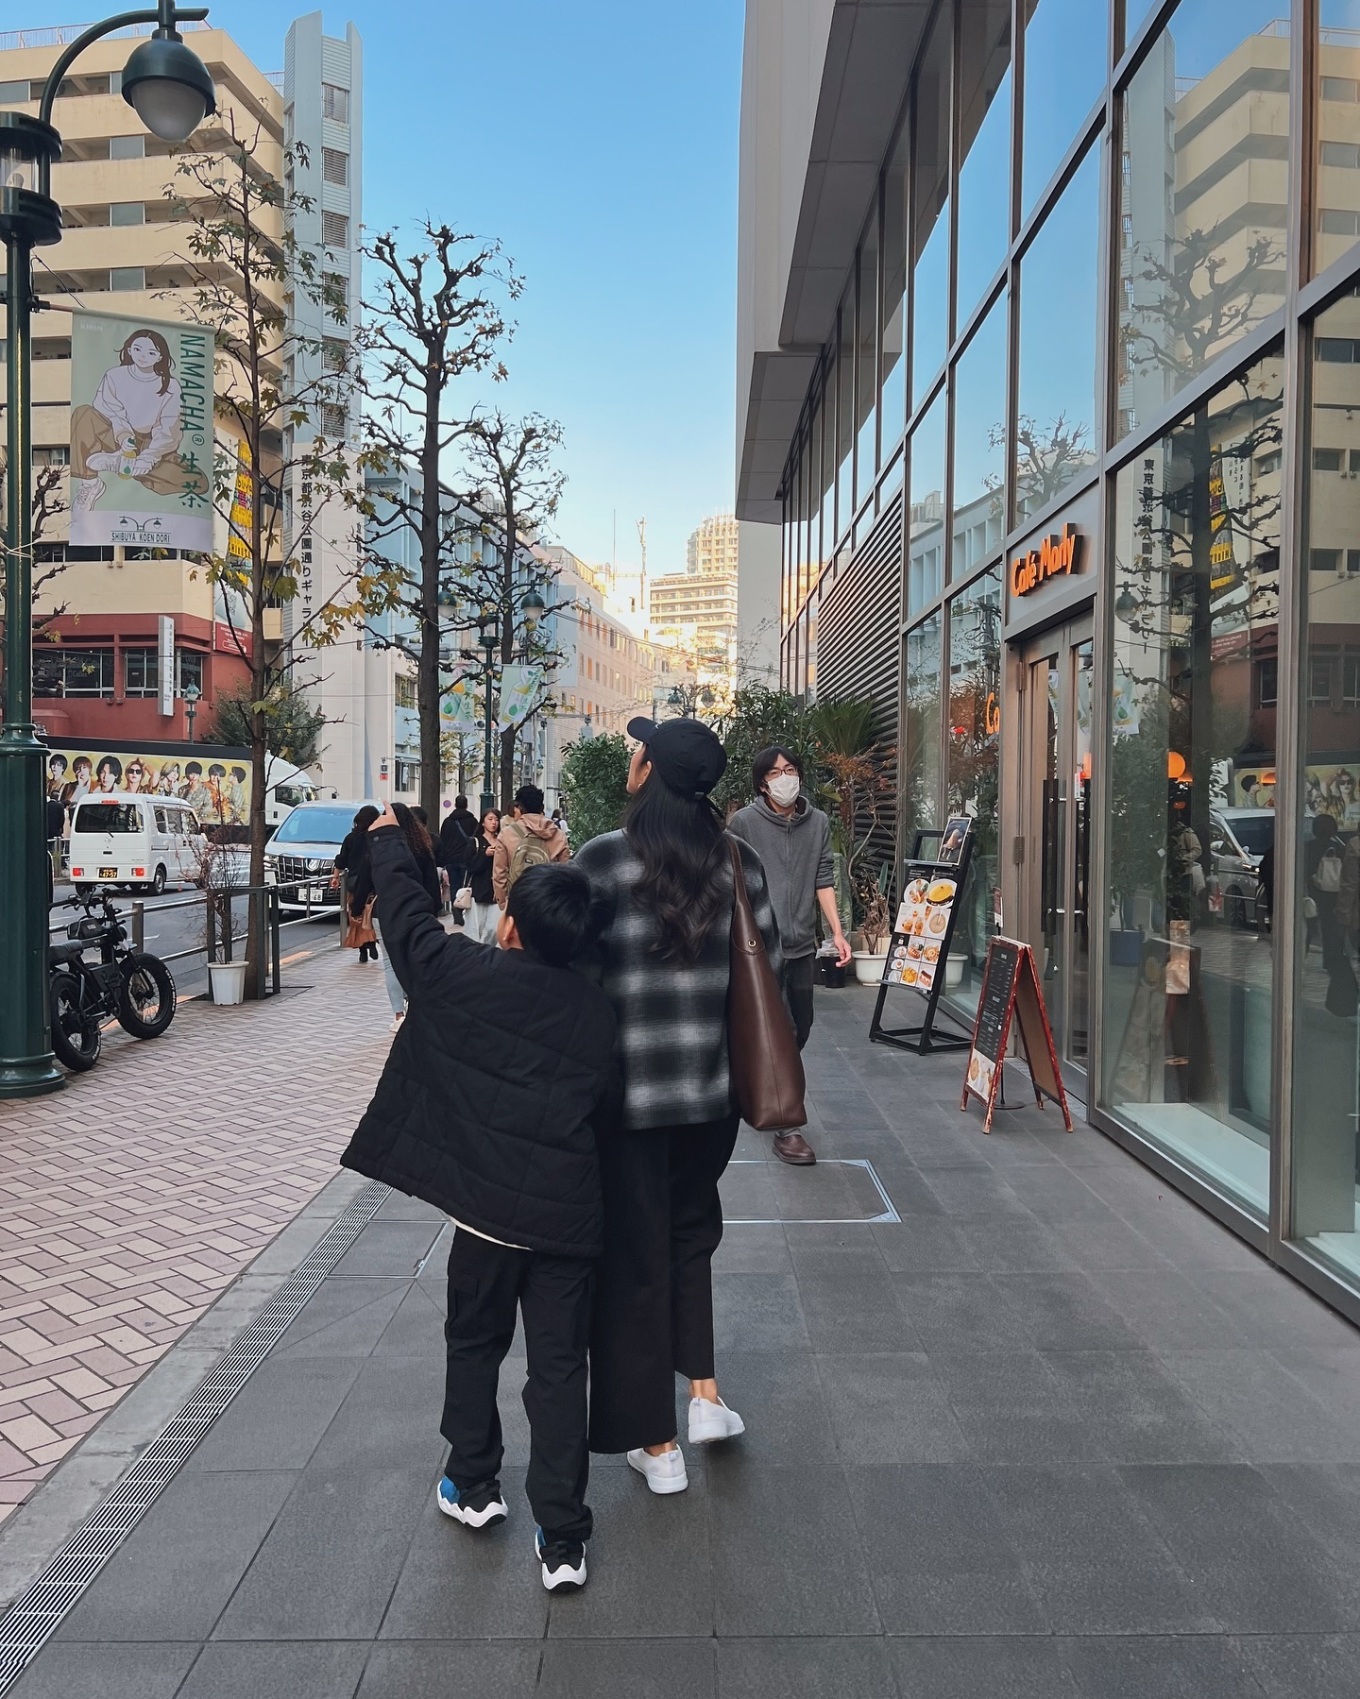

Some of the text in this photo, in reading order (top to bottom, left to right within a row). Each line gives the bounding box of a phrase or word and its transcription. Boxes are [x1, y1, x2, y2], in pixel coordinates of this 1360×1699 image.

[180, 333, 205, 431] NAMACHA
[178, 450, 209, 508] 生茶
[111, 532, 170, 543] SHIBUYA KOEN DORI
[1012, 552, 1036, 598] Café
